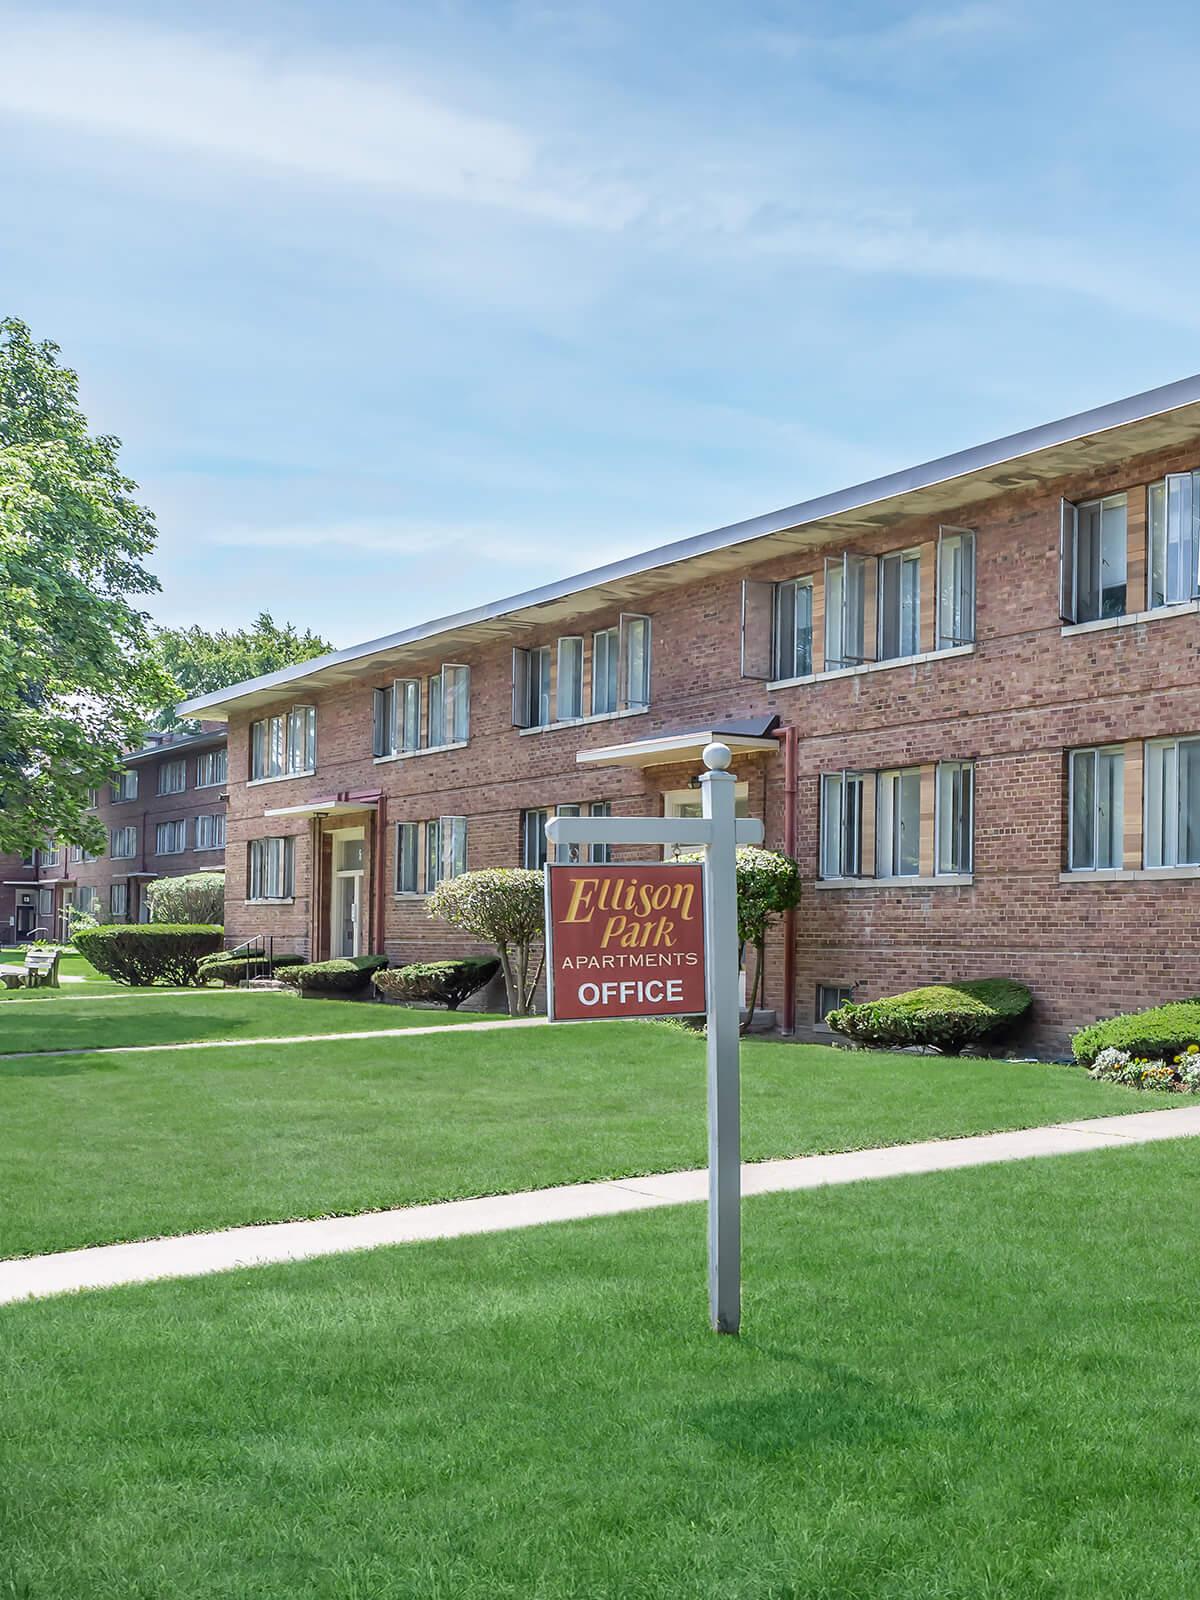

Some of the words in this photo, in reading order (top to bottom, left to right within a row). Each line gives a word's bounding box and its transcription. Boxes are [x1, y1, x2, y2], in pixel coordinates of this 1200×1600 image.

[558, 878, 695, 924] Ellison
[600, 915, 677, 949] Park
[562, 952, 698, 969] APARTMENTS
[578, 980, 684, 1006] OFFICE
